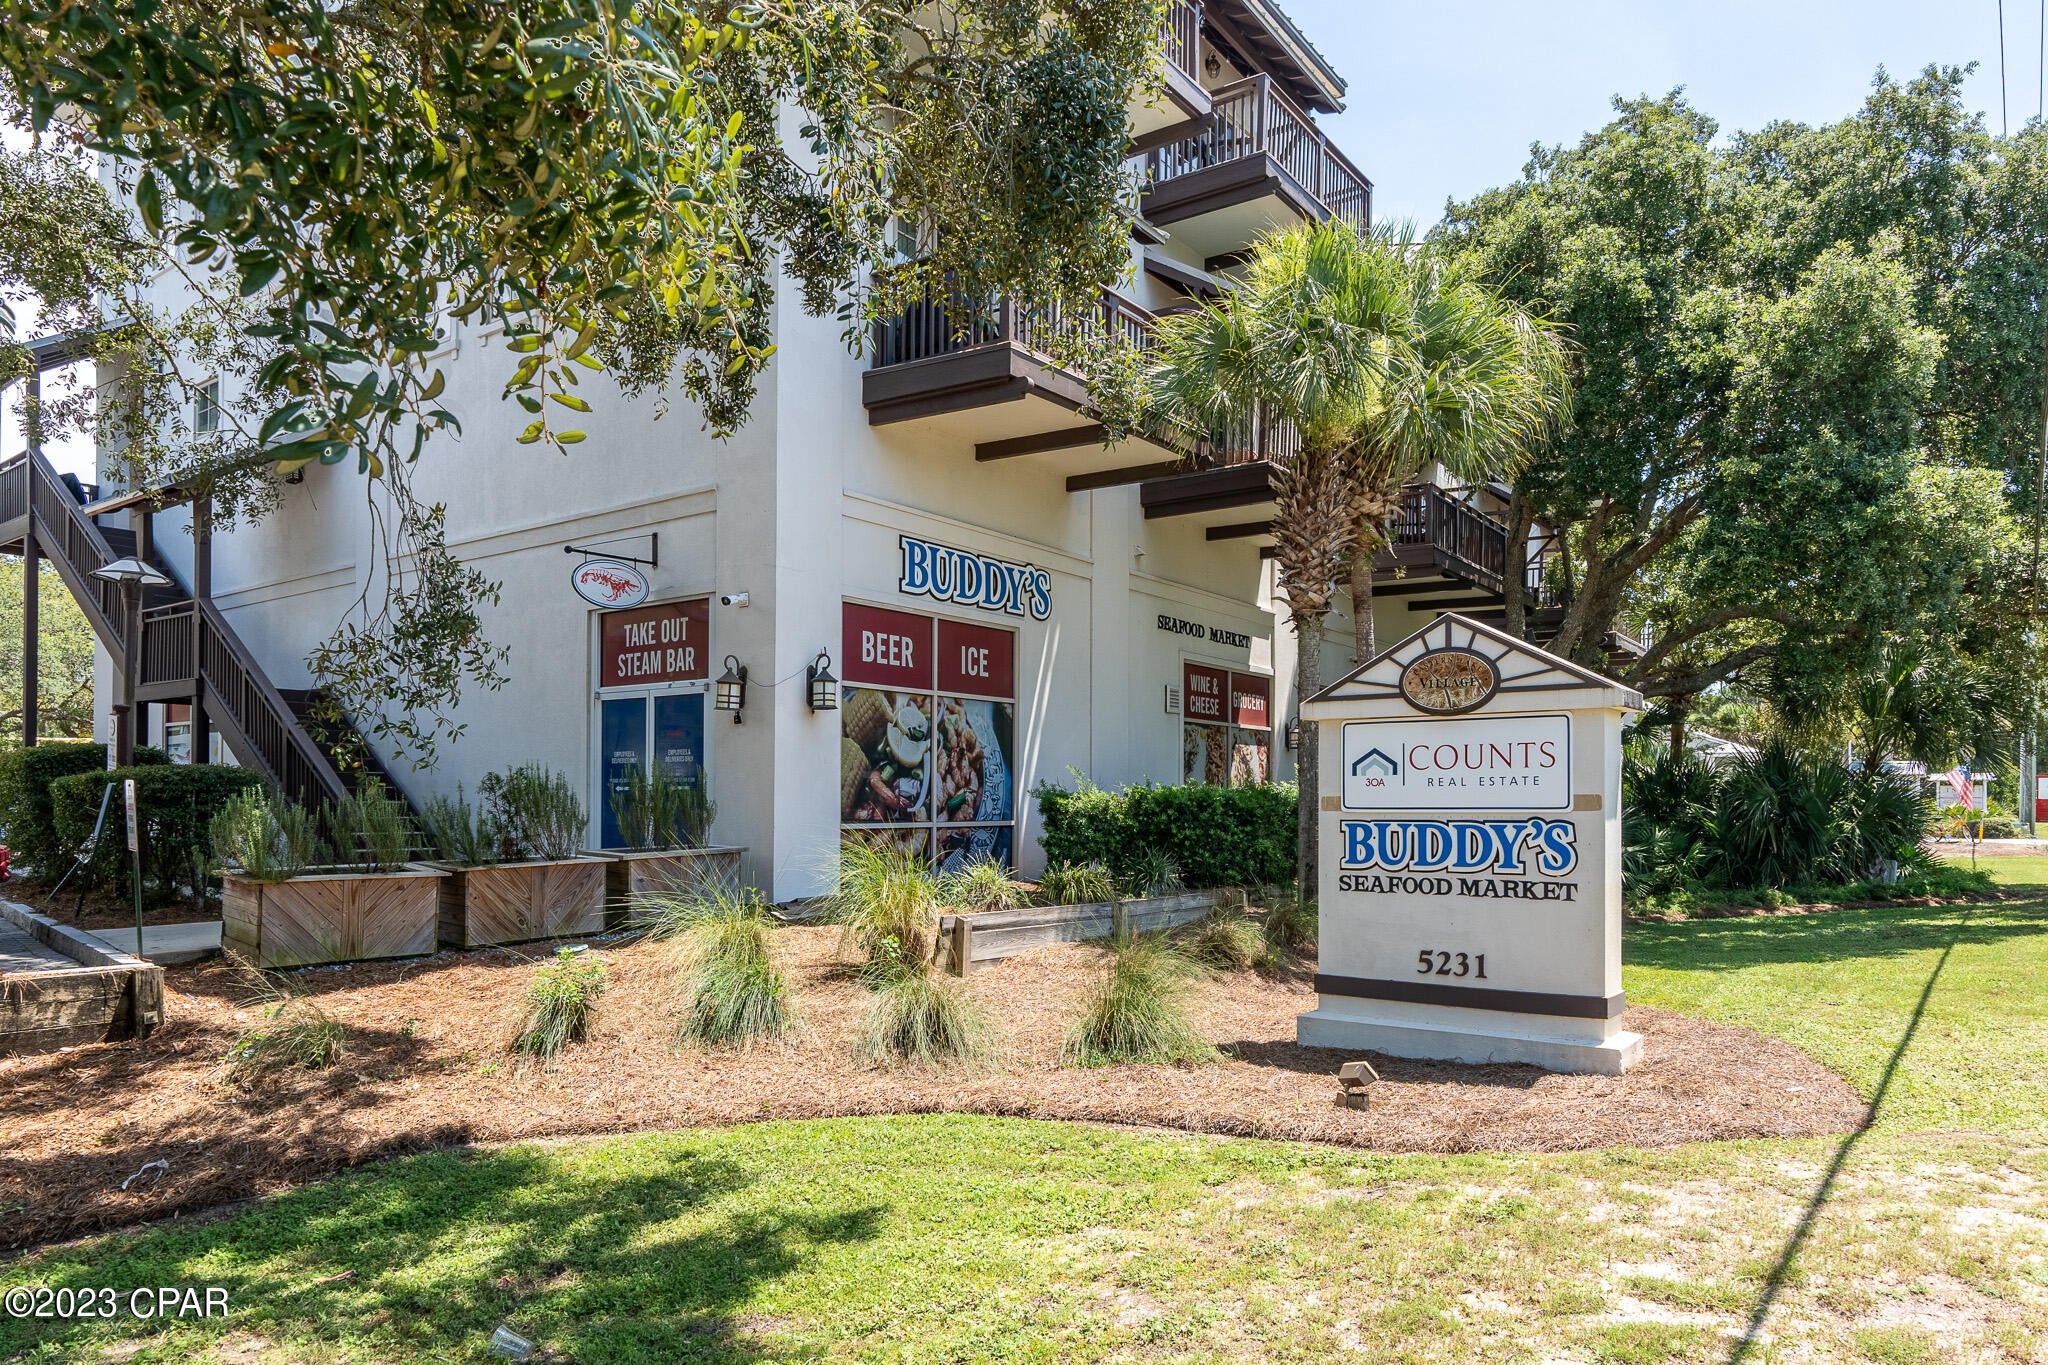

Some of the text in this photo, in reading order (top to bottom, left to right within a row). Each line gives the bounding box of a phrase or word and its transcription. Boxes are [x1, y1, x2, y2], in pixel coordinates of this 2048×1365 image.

[900, 535, 1051, 620] BUDDY'S
[624, 617, 688, 647] TAKE OUT
[1158, 615, 1250, 648] SEAFOOD MARKET
[617, 647, 695, 677] STEAM BAR
[862, 630, 913, 668] BEER
[961, 645, 989, 678] ICE
[1190, 674, 1219, 695] WINE &
[1420, 675, 1476, 688] VILLAGE
[1190, 695, 1219, 716] CHEESE
[1233, 691, 1265, 711] GROCERY
[1409, 741, 1556, 771] COUNTS
[1365, 778, 1385, 787] 30A
[1427, 775, 1541, 787] REAL ESTATE
[1340, 817, 1578, 877] BUDDY'S
[1339, 875, 1578, 902] SEAFOOD MARKET
[1417, 950, 1488, 979] 5231
